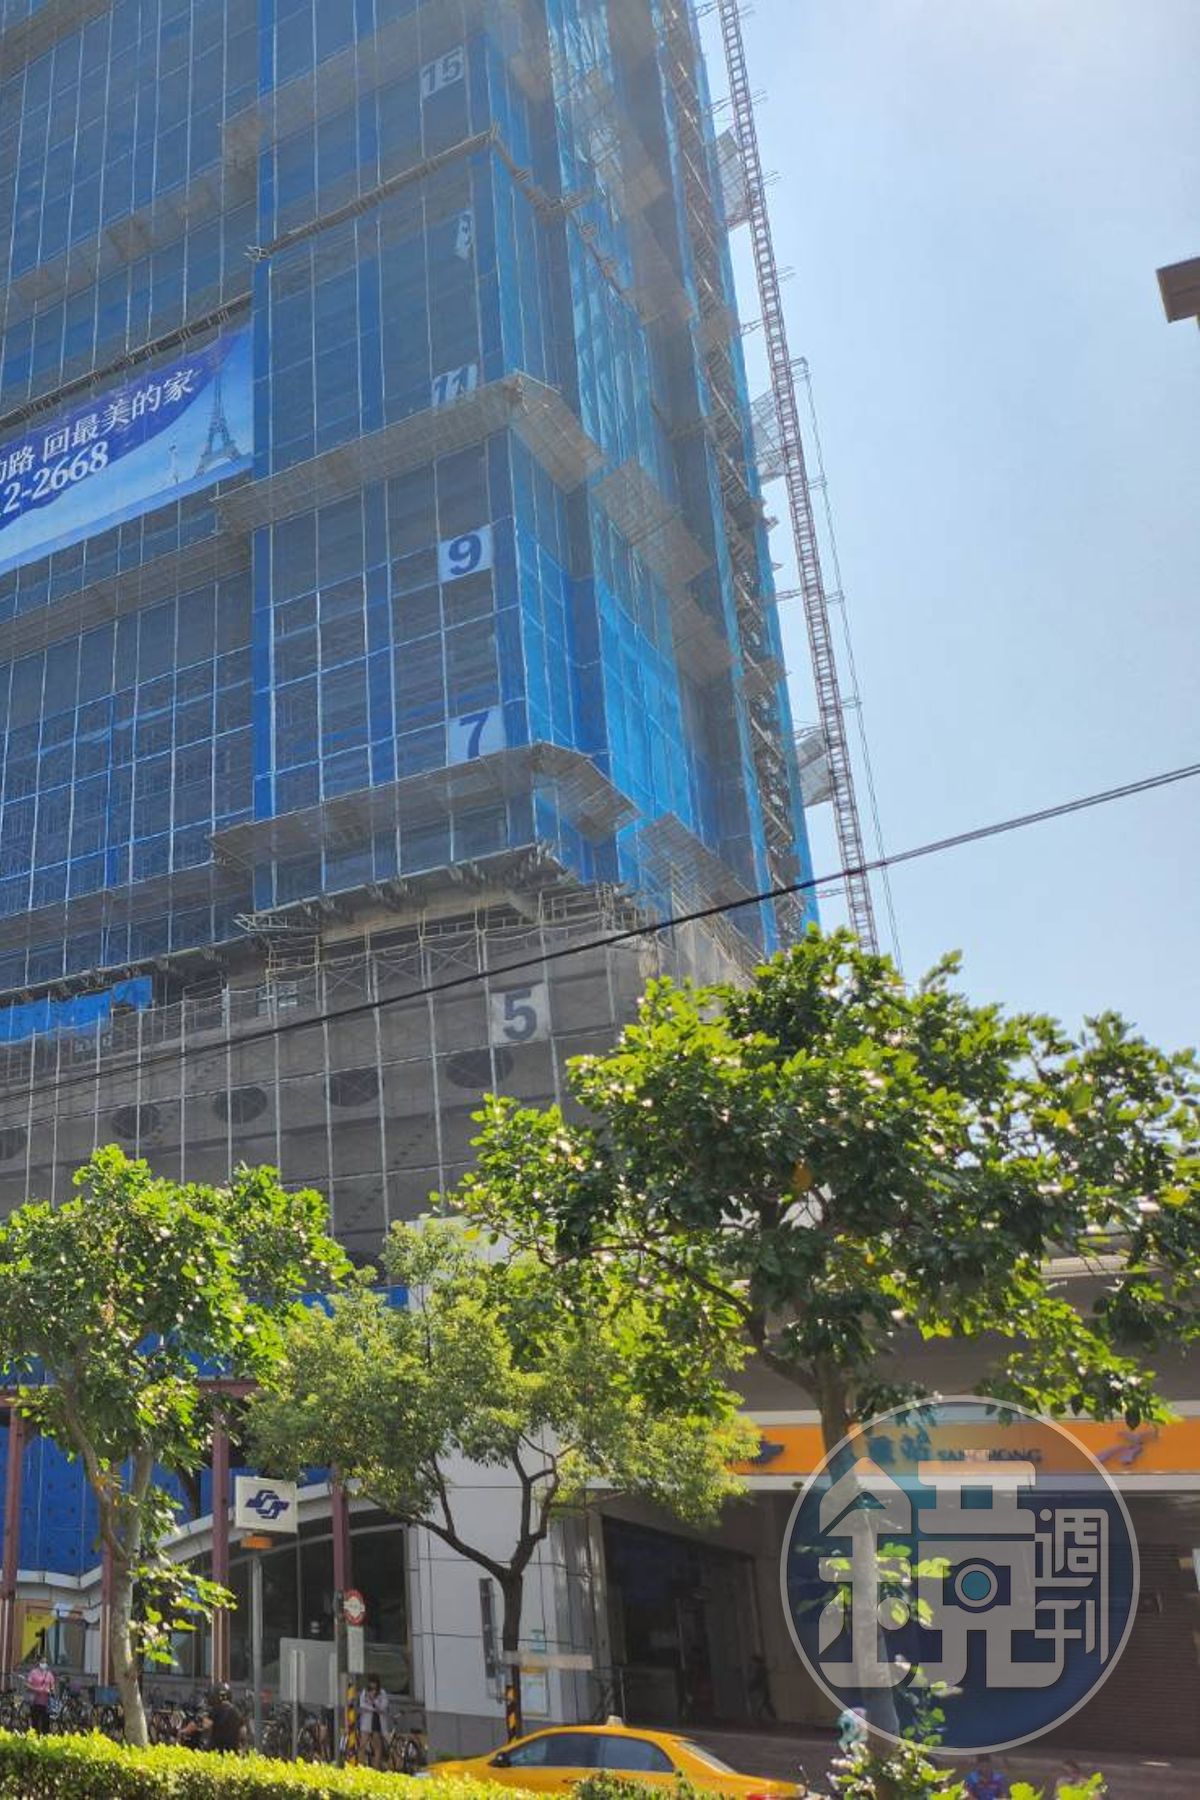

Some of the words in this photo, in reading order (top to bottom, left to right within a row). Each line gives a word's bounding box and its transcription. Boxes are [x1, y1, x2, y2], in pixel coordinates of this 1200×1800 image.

[421, 49, 462, 93] 15
[42, 368, 195, 463] 回最美的家
[448, 533, 483, 576] 9
[458, 710, 491, 760] 7
[503, 988, 538, 1041] 5
